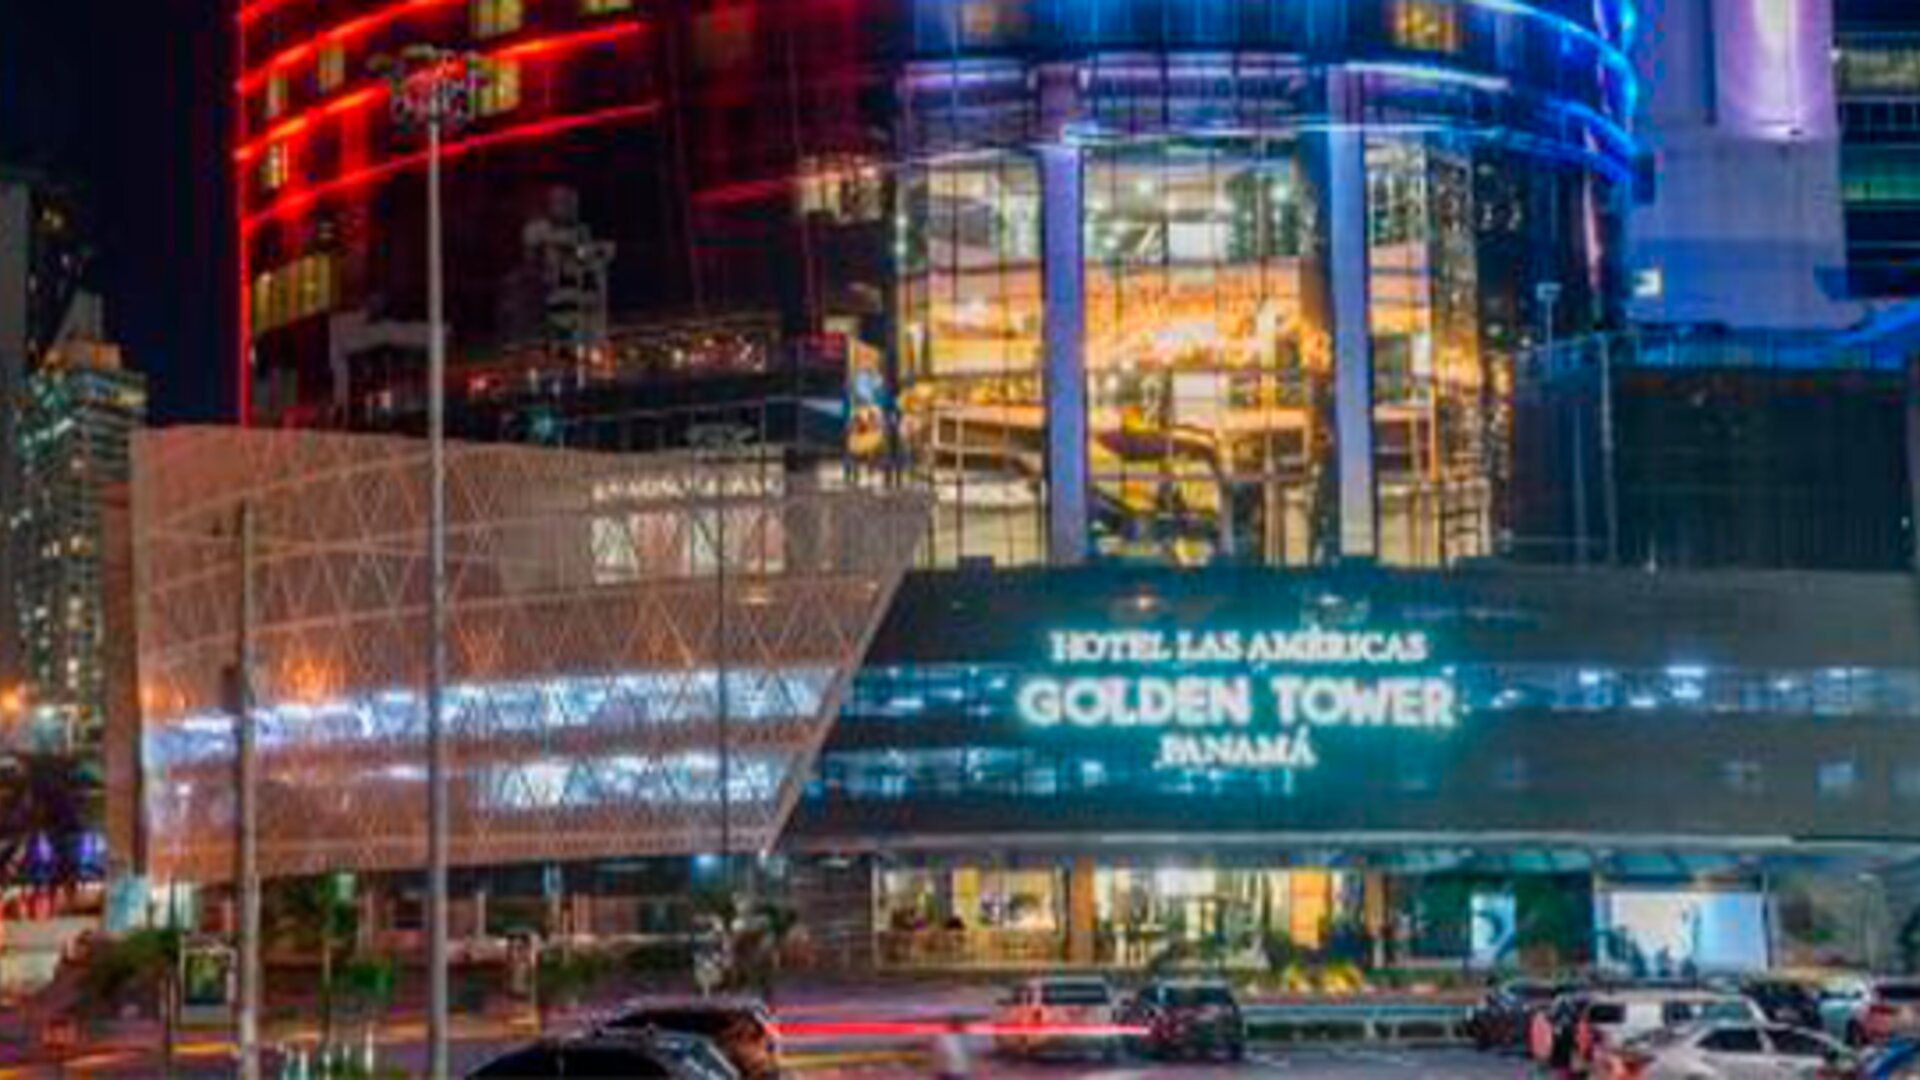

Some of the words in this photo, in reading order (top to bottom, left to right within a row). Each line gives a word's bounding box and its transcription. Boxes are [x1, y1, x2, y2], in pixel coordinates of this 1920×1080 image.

[1049, 631, 1170, 663] HOTEL
[1178, 631, 1241, 662] LAS
[1246, 622, 1429, 663] AMÉRICAS
[1018, 676, 1251, 726] GOLDEN
[1271, 676, 1456, 726] TOWER
[1156, 726, 1317, 768] PANAMÁ
